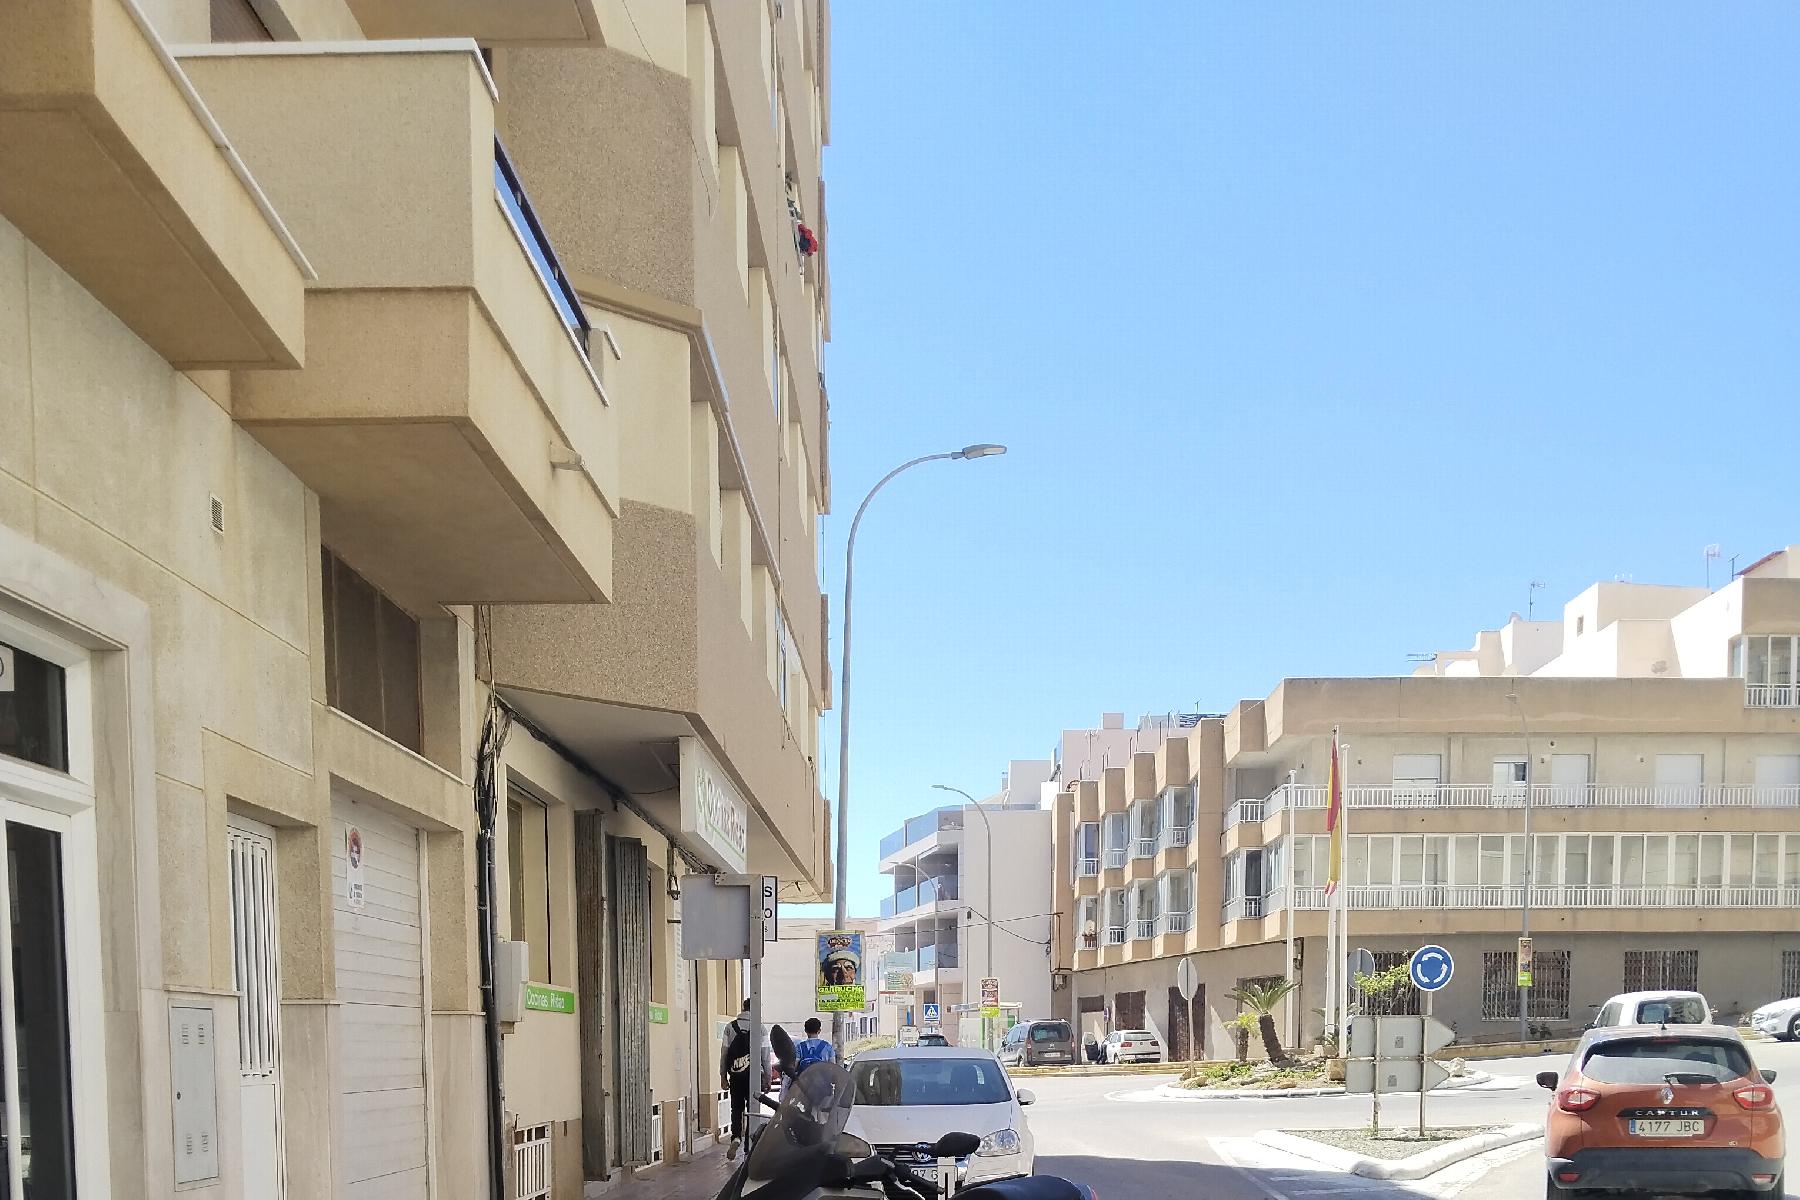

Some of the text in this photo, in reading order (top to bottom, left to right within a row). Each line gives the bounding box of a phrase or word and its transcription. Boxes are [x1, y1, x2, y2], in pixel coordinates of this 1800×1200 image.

[527, 989, 548, 1007] Cocinas
[1638, 1121, 1700, 1132] 4177 JBC
